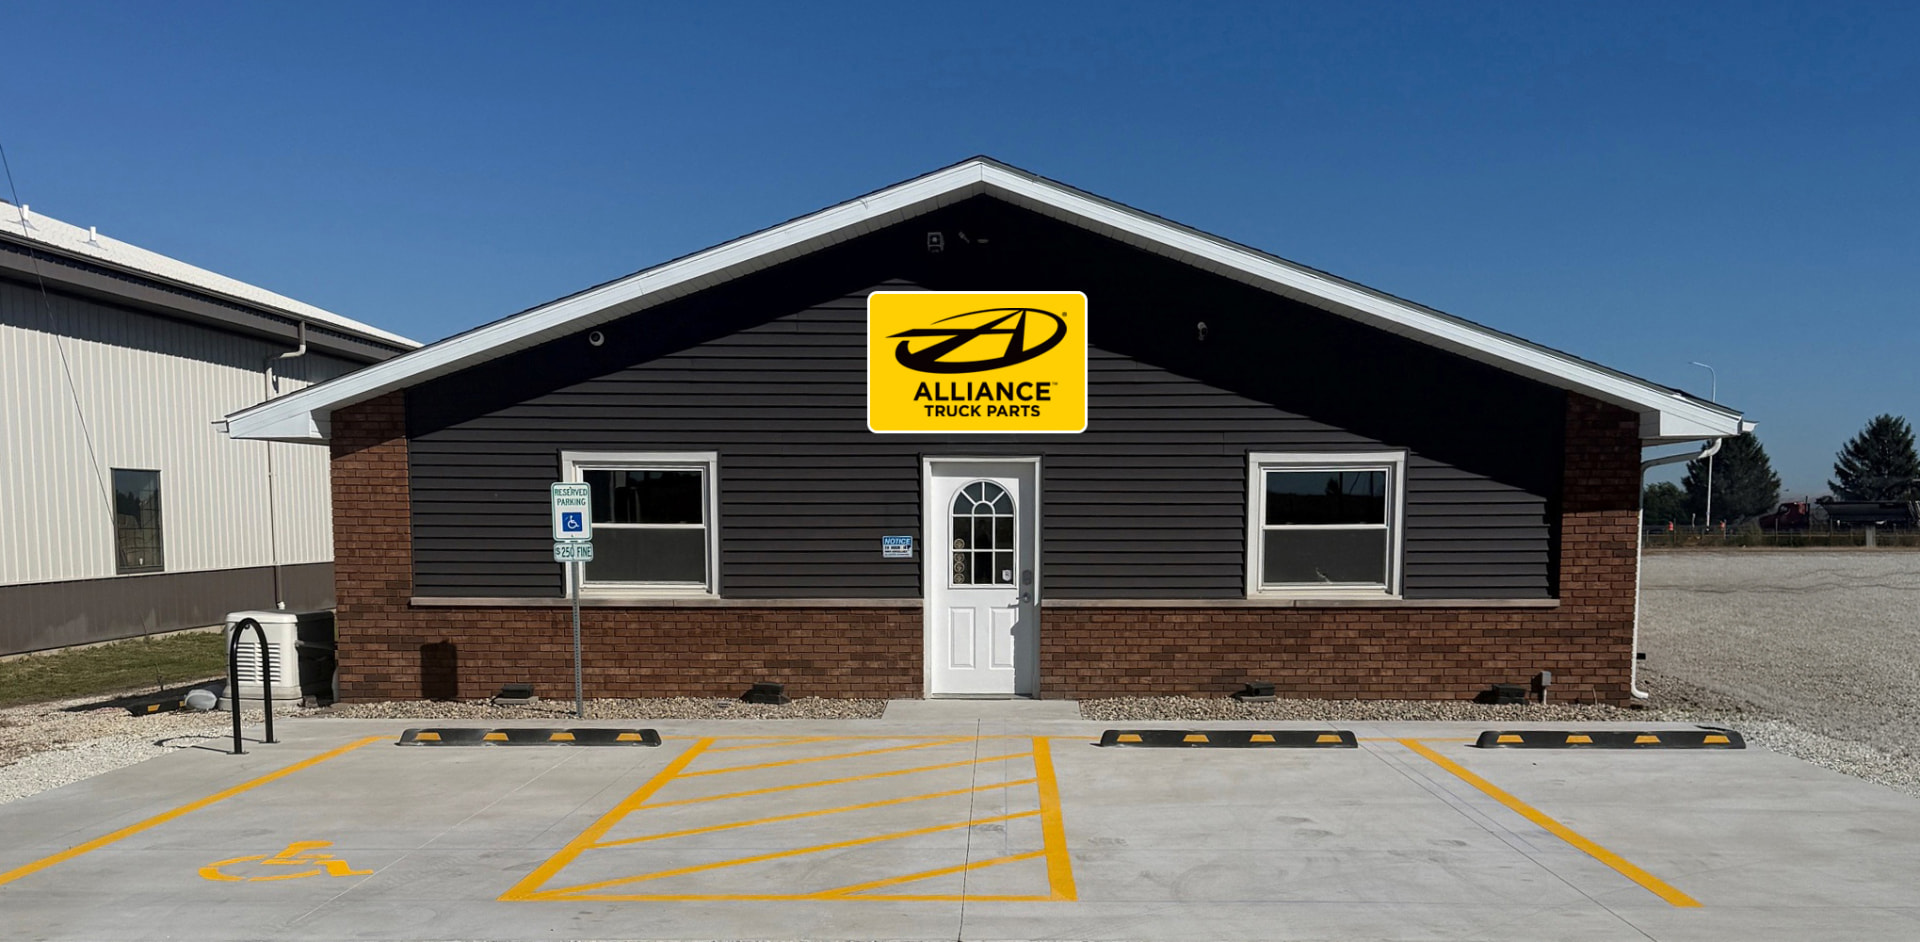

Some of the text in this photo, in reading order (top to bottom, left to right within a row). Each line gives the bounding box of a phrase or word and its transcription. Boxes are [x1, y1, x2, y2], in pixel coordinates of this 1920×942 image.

[913, 381, 1051, 401] ALLIANCE
[924, 405, 1041, 417] TRUCK PARTS
[557, 498, 586, 506] PARKING
[576, 546, 592, 558] FINE
